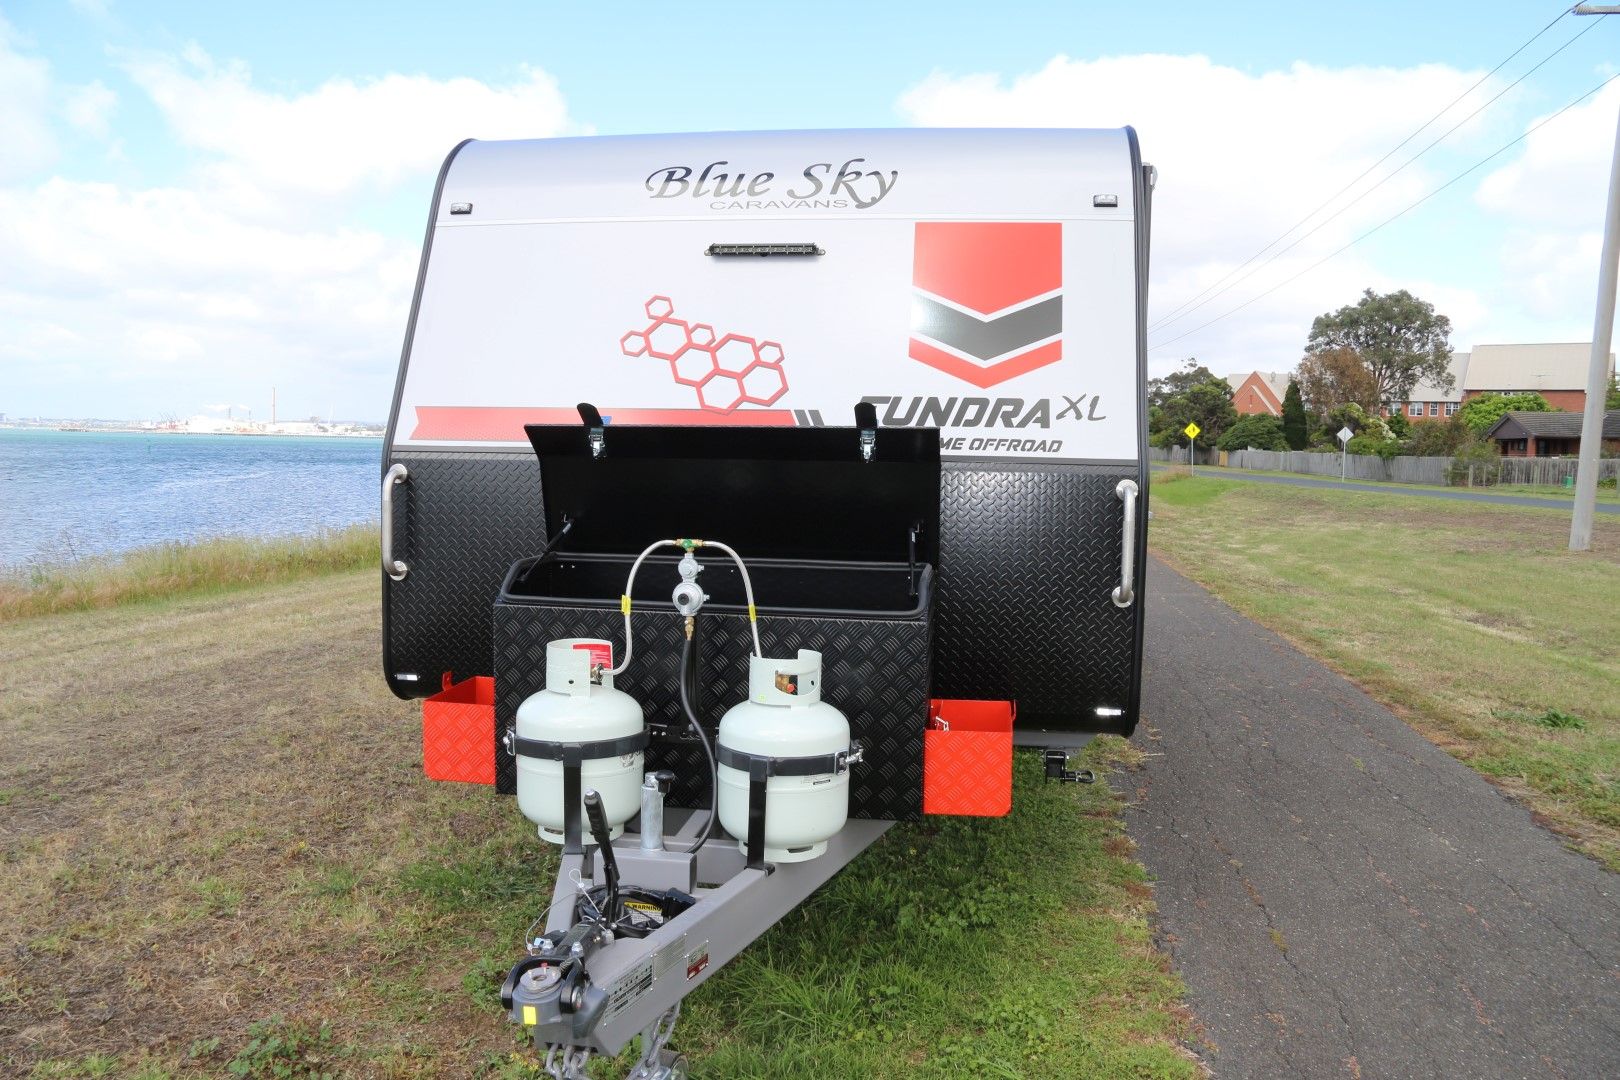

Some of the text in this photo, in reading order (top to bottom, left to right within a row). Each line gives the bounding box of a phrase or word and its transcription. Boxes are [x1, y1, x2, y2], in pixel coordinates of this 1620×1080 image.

[644, 158, 899, 209] Blue Sky
[709, 199, 849, 210] CARAVANS
[1056, 393, 1107, 421] XL
[968, 437, 1063, 453] OFFROAD
